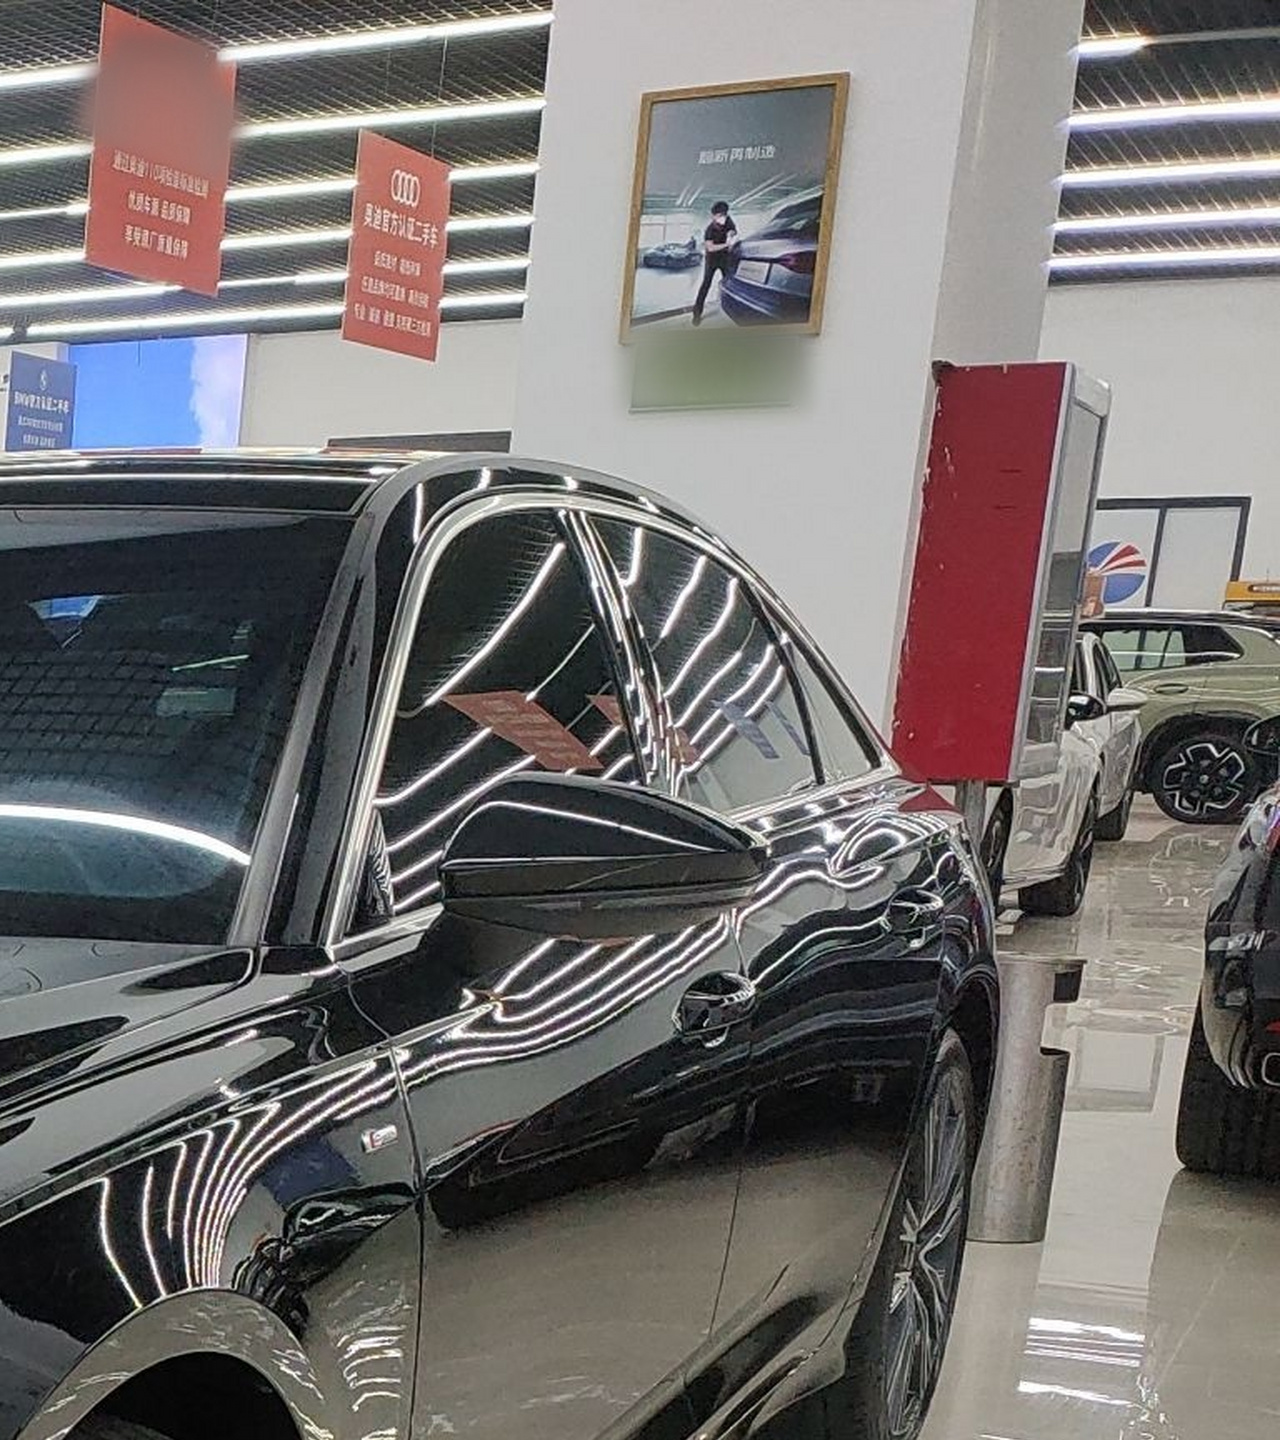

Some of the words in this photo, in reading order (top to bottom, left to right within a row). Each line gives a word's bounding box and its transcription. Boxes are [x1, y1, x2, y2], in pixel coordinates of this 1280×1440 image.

[364, 203, 438, 248] 奥迪官方认证二手车
